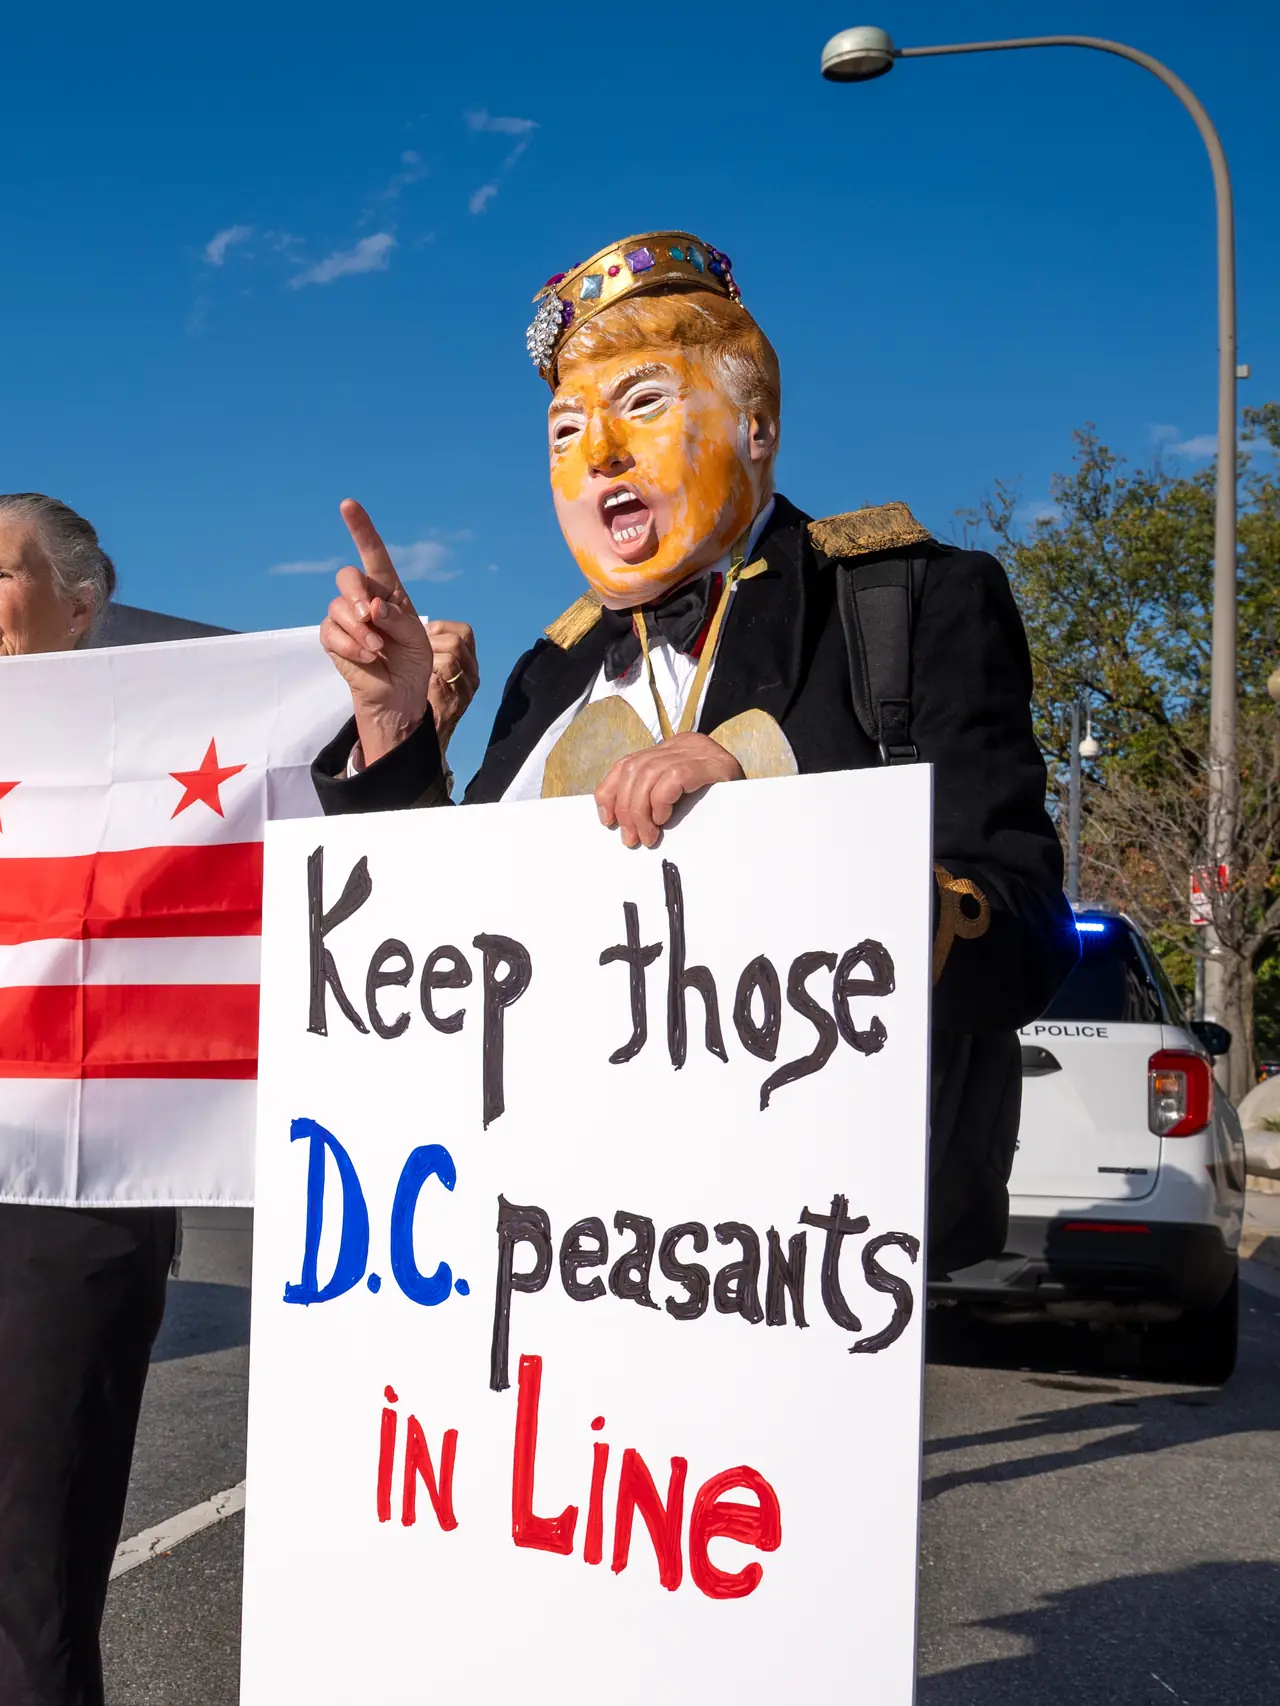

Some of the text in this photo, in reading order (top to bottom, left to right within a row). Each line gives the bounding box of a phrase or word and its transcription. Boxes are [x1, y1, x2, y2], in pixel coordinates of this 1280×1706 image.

[306, 844, 896, 1132] Keep those
[1034, 1025, 1109, 1039] POLICE
[282, 1117, 921, 1393] D.C. peasants
